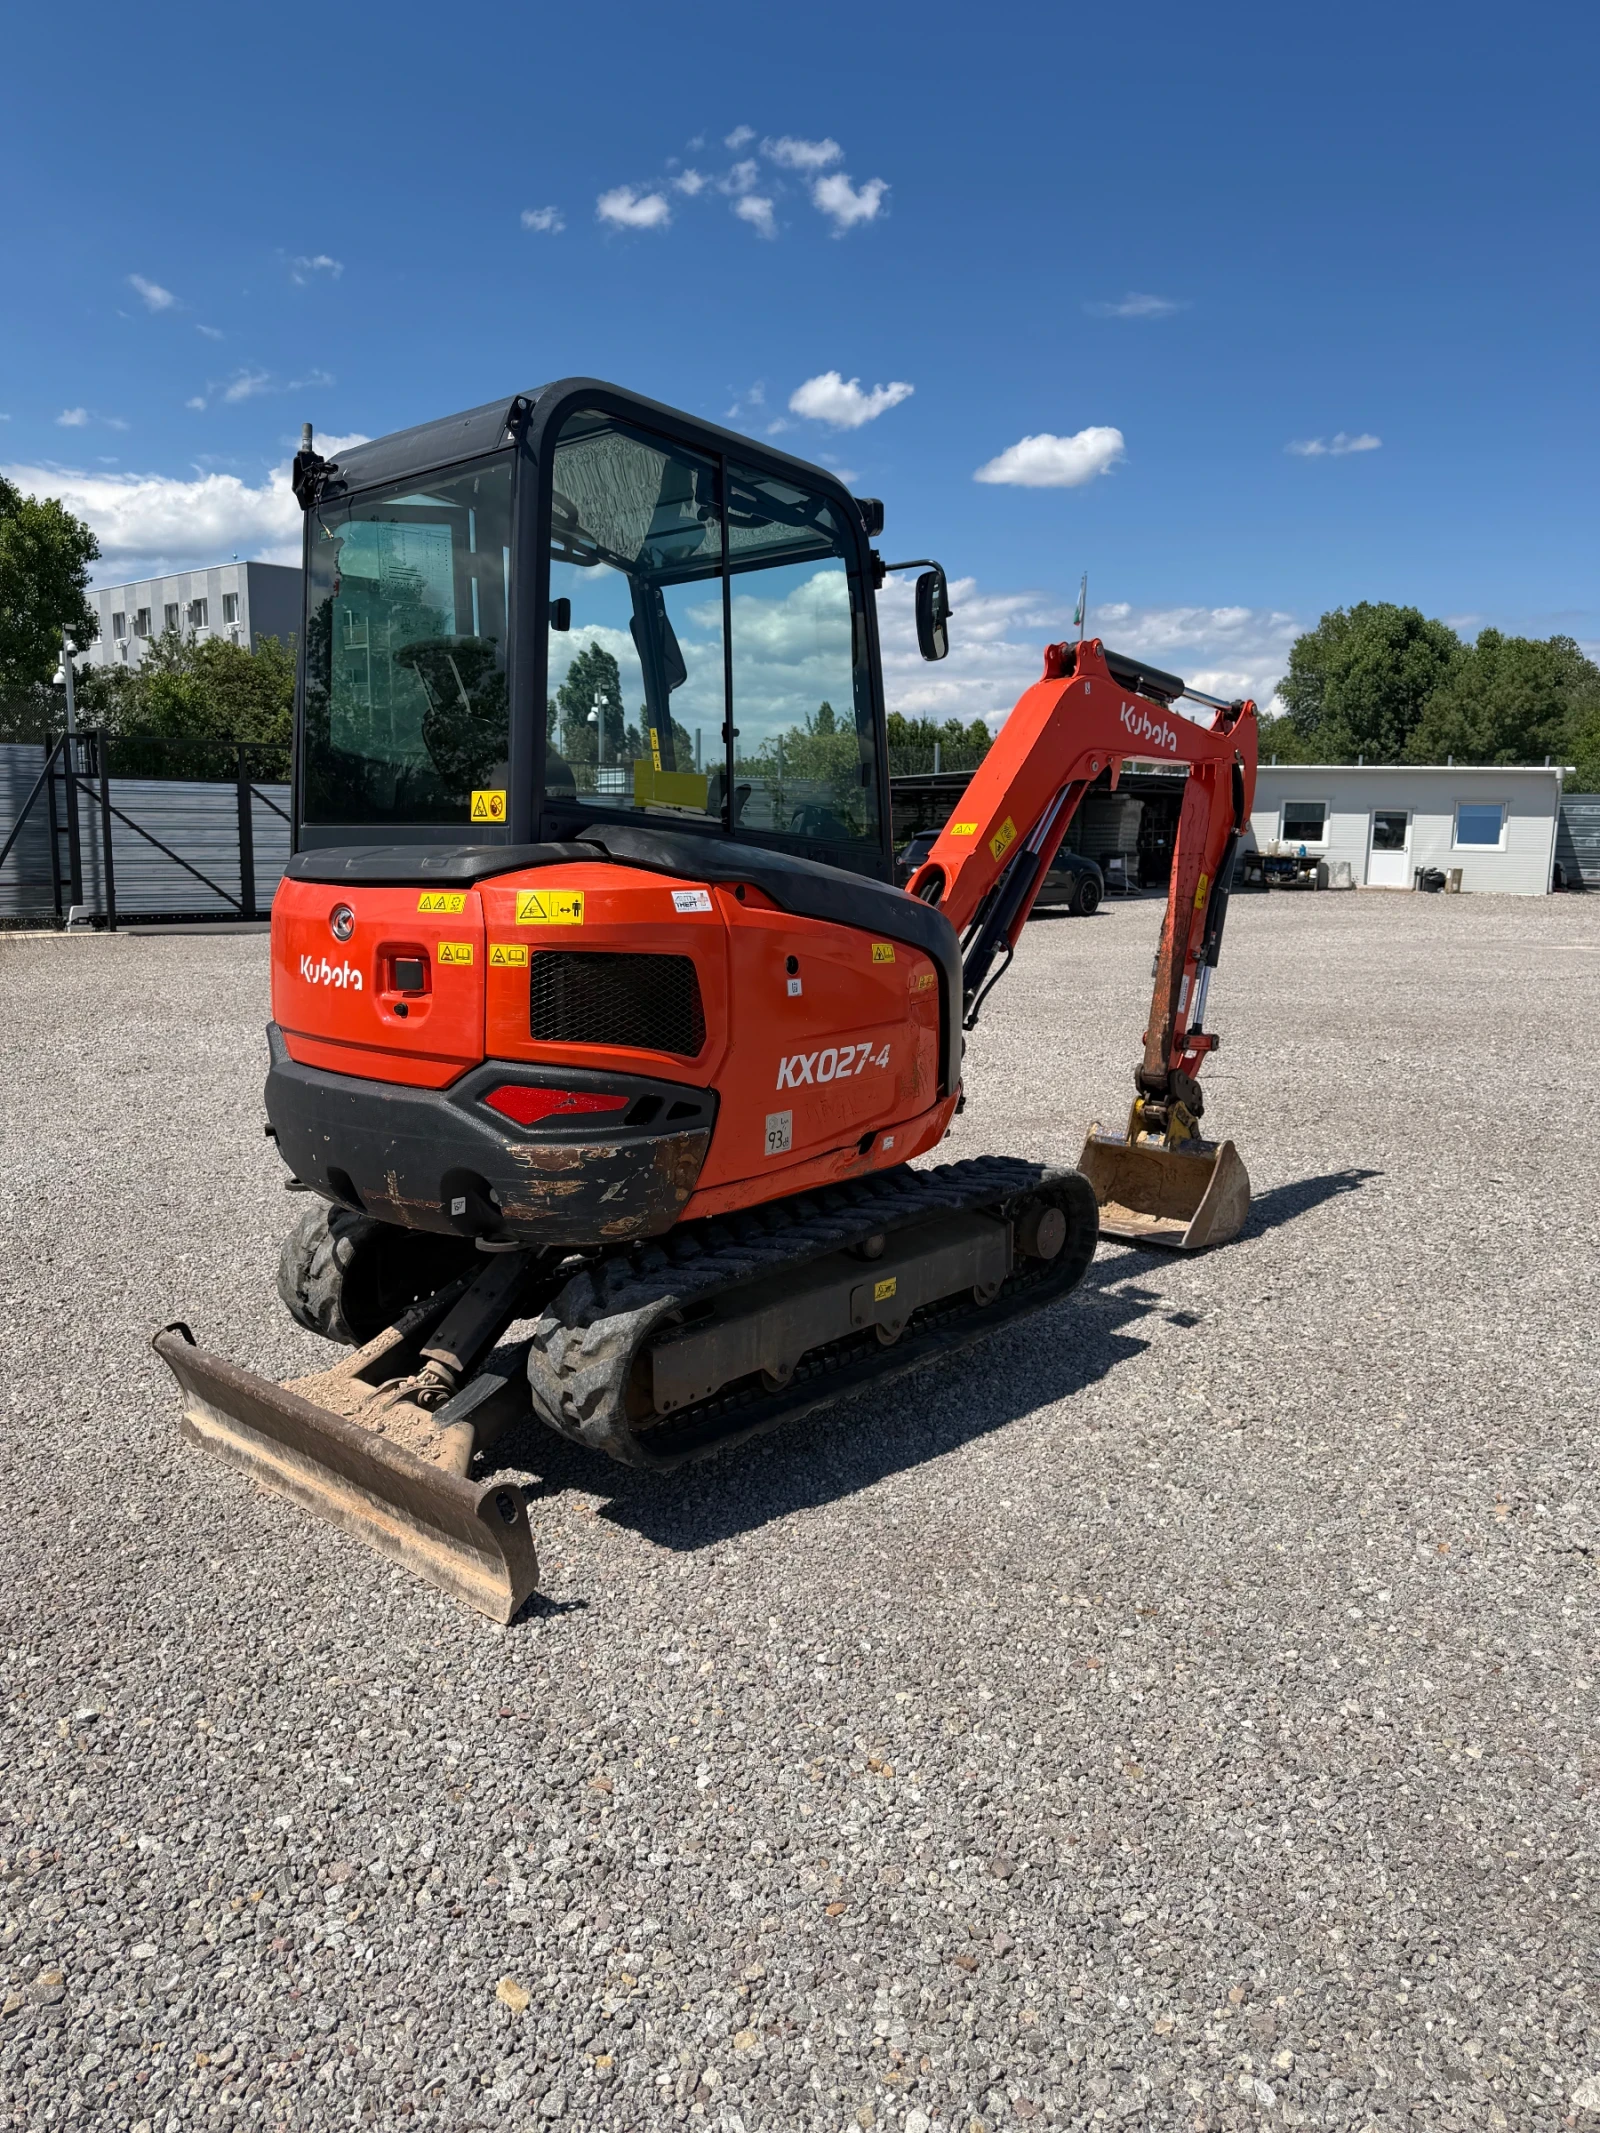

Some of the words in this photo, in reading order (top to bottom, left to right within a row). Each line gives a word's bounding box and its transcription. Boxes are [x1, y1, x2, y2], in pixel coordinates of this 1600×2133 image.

[1120, 701, 1177, 752] Kubota
[300, 954, 363, 991] Kubota
[776, 1042, 891, 1091] KX027-4
[768, 1130, 783, 1150] 93
